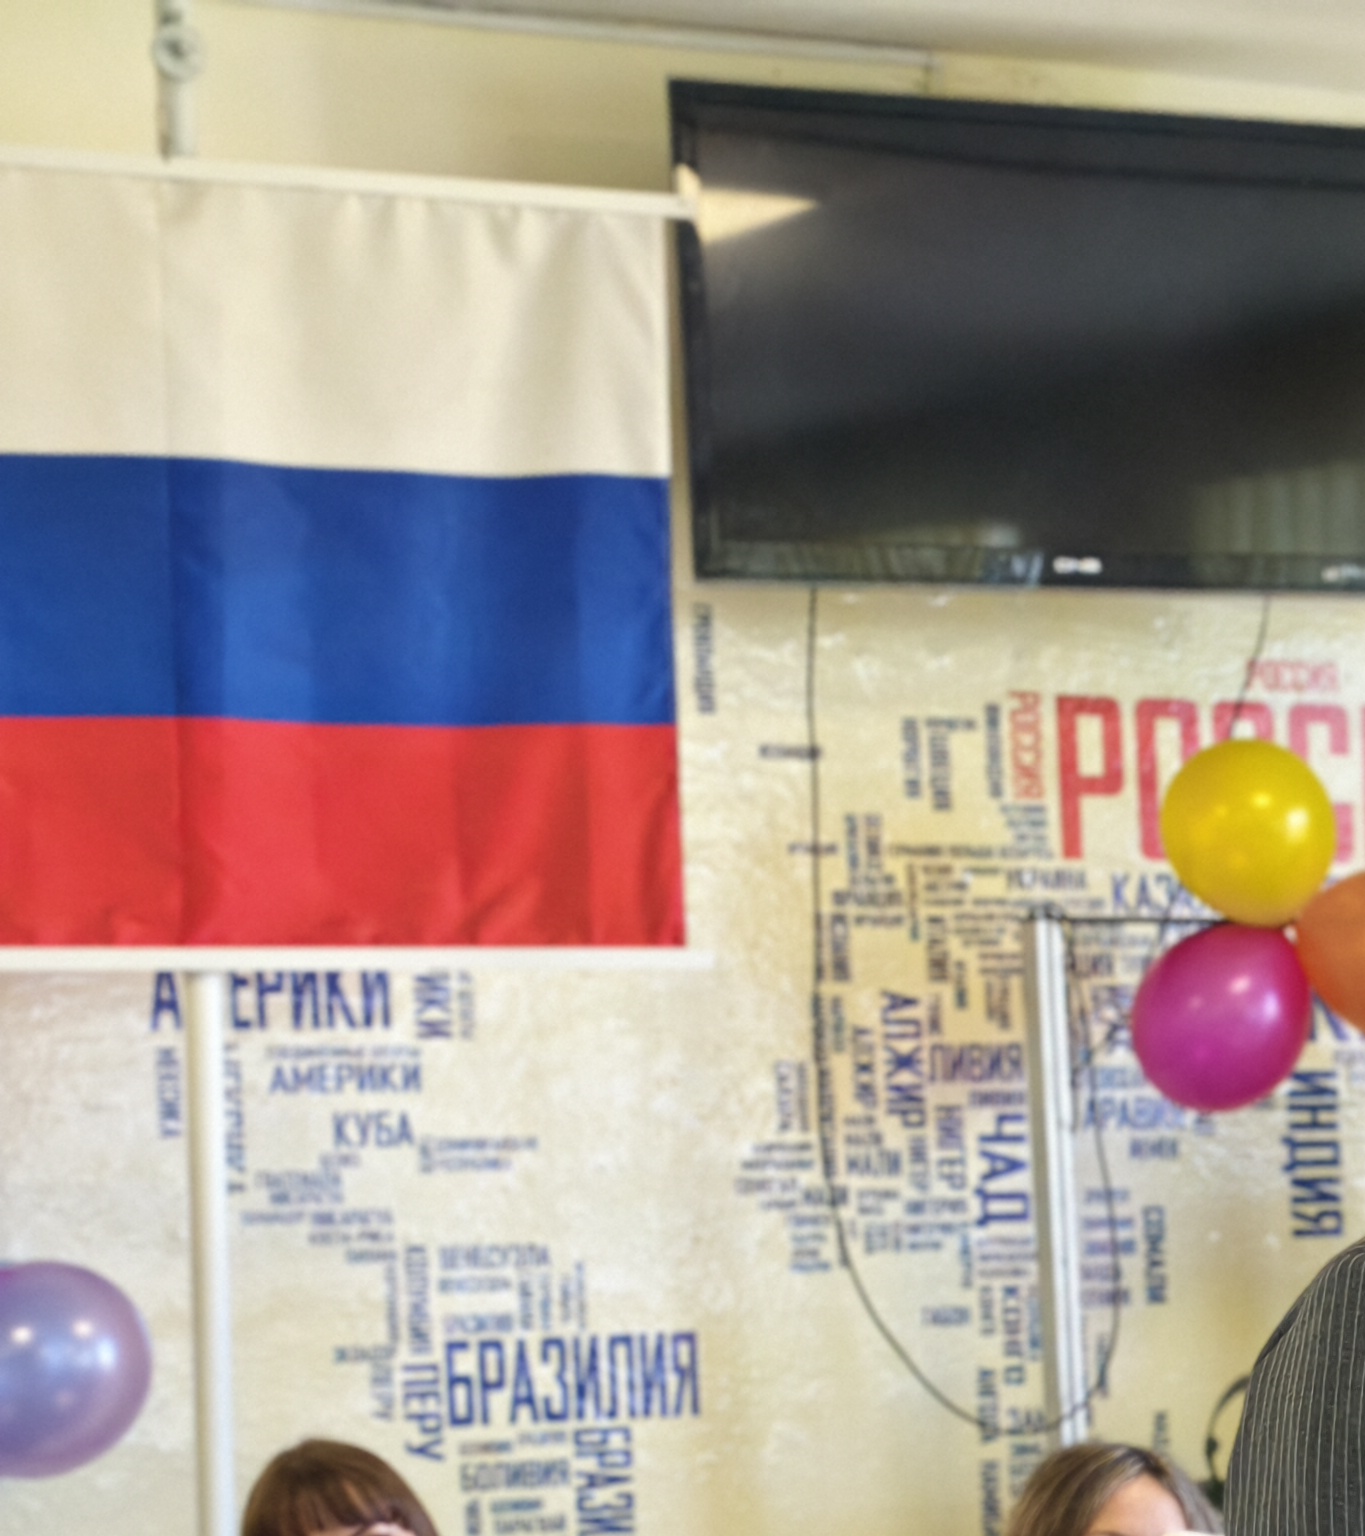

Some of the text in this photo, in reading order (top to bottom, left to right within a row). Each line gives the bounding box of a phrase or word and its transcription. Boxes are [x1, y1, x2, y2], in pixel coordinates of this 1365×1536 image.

[1246, 658, 1339, 691] РОССИЯ
[1009, 690, 1045, 799] РОССИЯ
[149, 971, 392, 1031] АЕРИКИ
[269, 1063, 422, 1093] АМЕРИКИ
[881, 991, 926, 1128] АЛЖИР
[929, 1044, 1024, 1083] ЛИВИЯ
[333, 1110, 415, 1149] КУБА
[936, 1105, 967, 1191] НИГЕР
[975, 1113, 1029, 1227] ЧАД
[1281, 1069, 1343, 1238] ИНДИЯ
[402, 1362, 447, 1462] ПЕРУ
[445, 1331, 701, 1428] БРАЗИЛИЯ
[459, 1458, 571, 1492] БОЛИВИЯ
